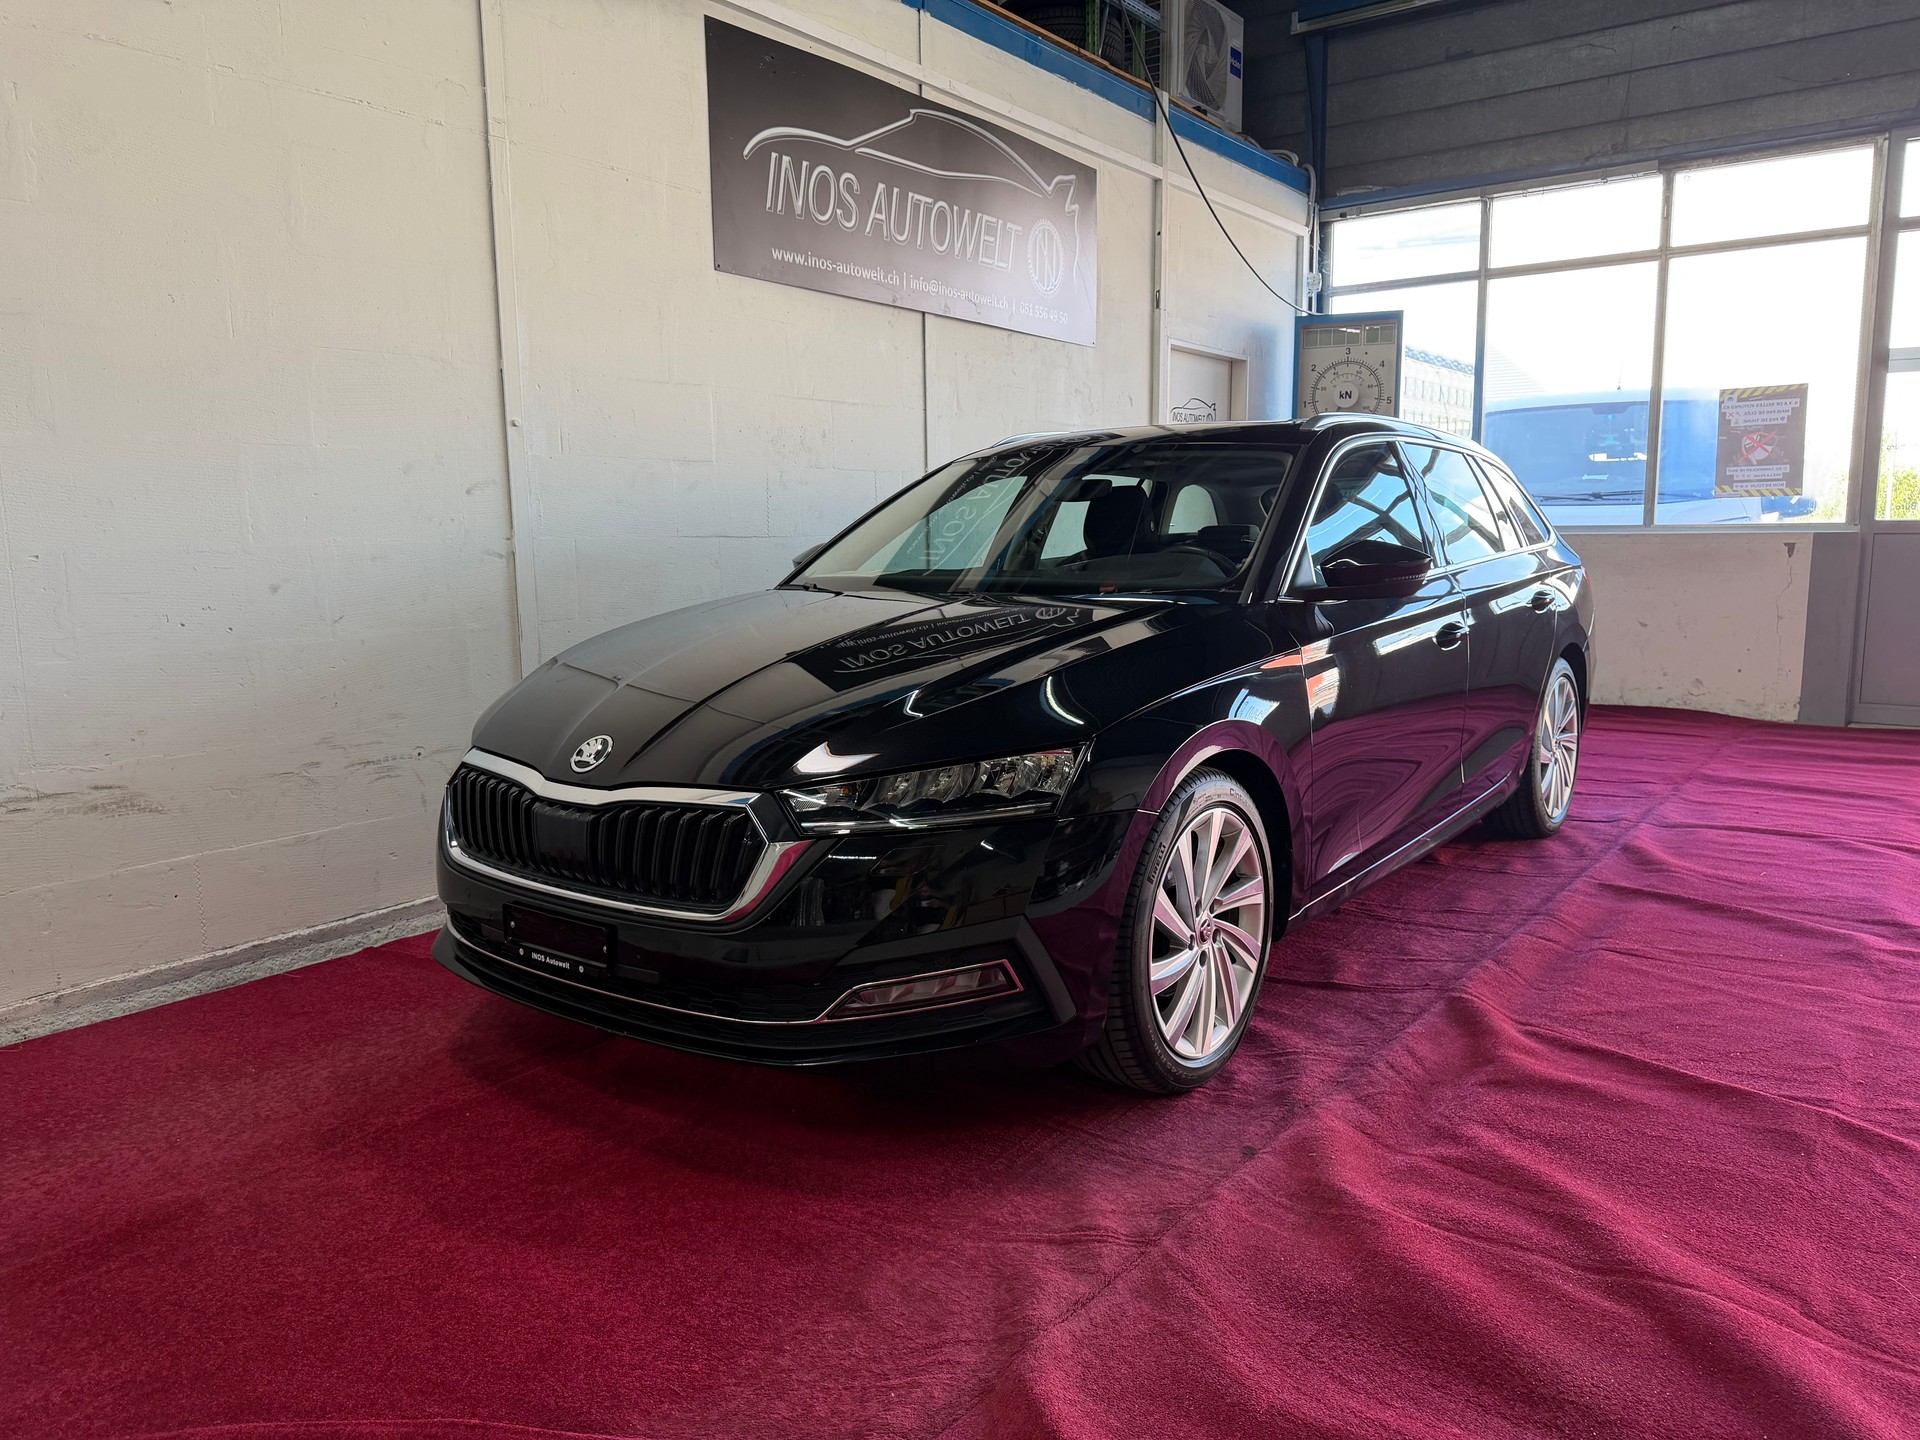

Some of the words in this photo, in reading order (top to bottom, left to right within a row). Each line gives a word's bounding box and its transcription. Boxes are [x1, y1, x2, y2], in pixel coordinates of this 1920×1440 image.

[766, 151, 860, 232] INOS
[865, 182, 1022, 272] AUTOWELT
[772, 247, 900, 286] www.inos-autowelt.ch
[910, 275, 1008, 310] info@inos-autowelt.ch
[1059, 312, 1068, 324] 50
[1339, 391, 1352, 399] kN
[532, 952, 545, 962] INOS
[546, 956, 570, 970] Autowelt
